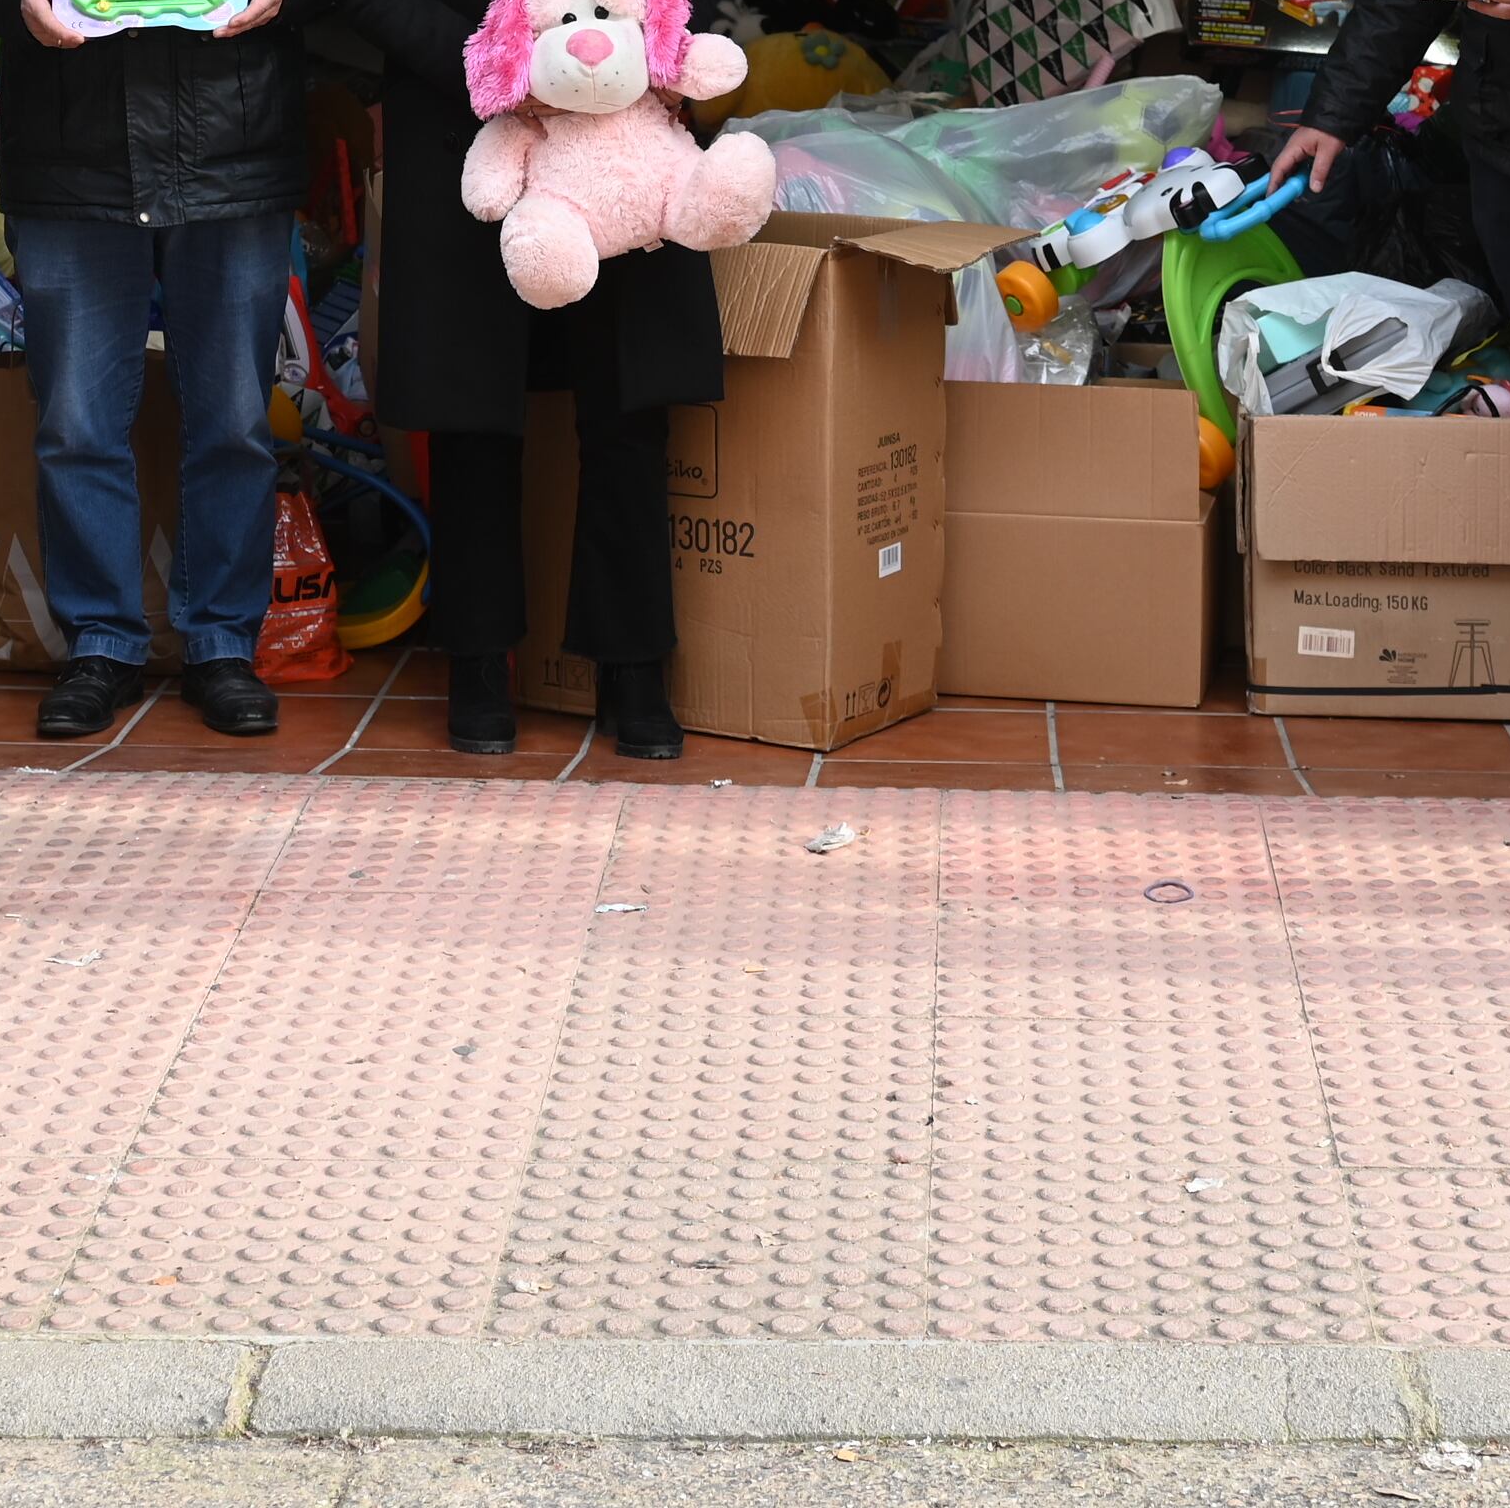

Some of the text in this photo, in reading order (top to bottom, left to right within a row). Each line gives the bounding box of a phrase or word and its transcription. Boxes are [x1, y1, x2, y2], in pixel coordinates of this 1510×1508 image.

[890, 444, 917, 471] 130182
[666, 460, 703, 480] tiko
[669, 514, 755, 559] 130182
[675, 557, 722, 575] 4 PZS
[1294, 562, 1333, 574] Color:
[1336, 562, 1372, 577] Black
[1380, 562, 1415, 578] Sand
[1386, 595, 1409, 611] 150
[1411, 596, 1428, 611] KG
